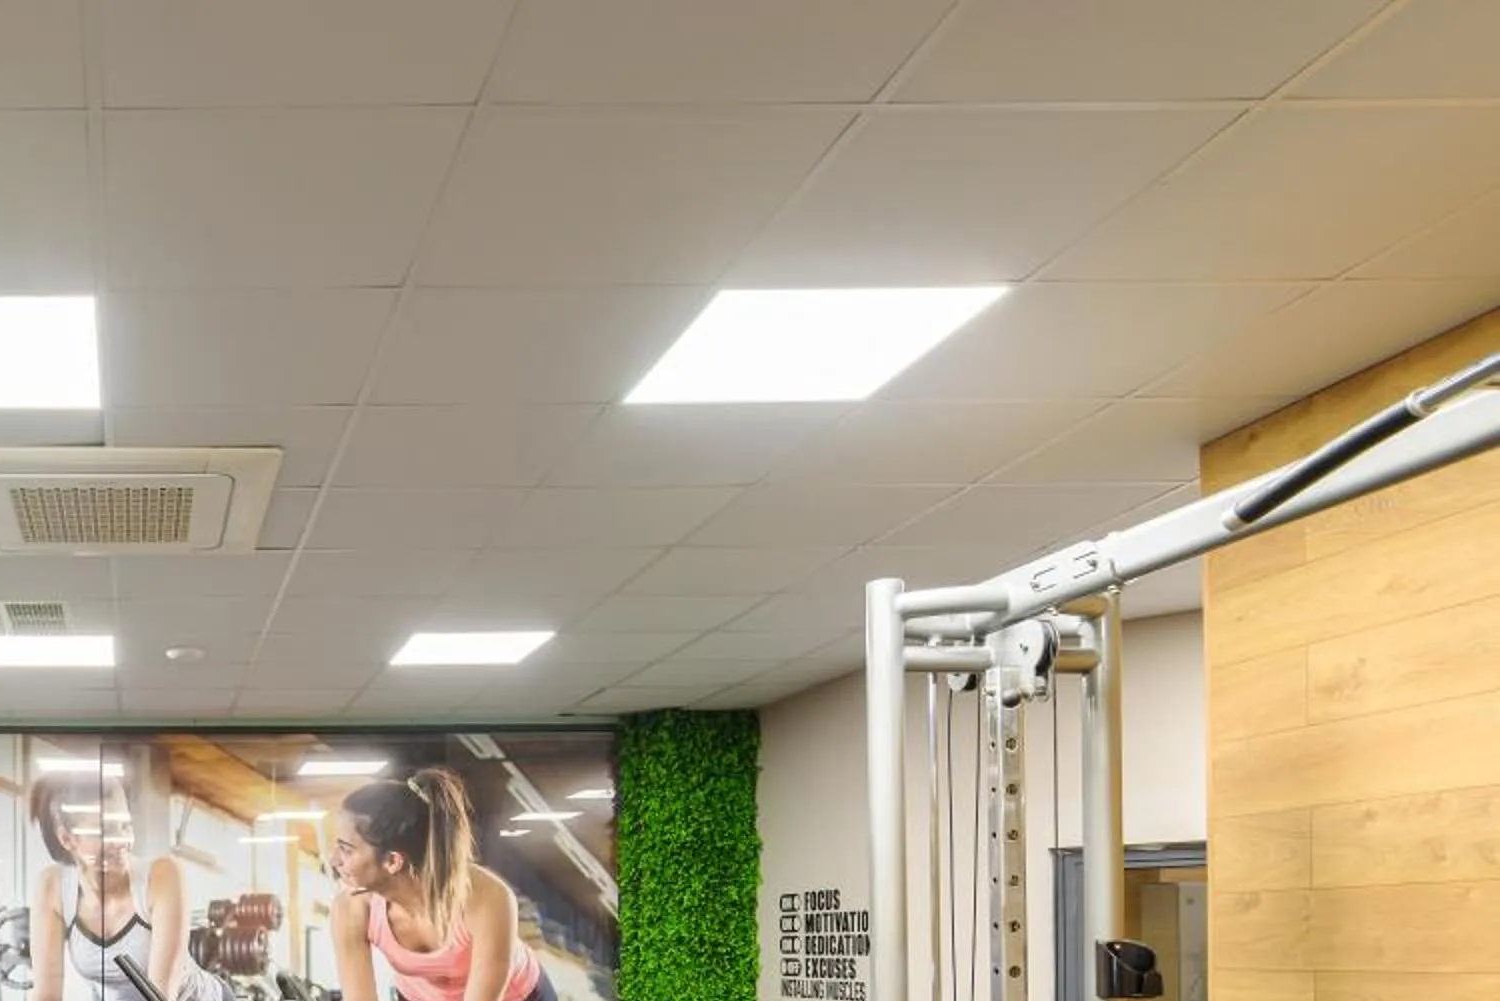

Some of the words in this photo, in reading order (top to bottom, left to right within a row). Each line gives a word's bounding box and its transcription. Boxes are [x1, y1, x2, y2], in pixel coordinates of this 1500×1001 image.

[804, 889, 840, 911] FOCUS
[804, 910, 869, 934] MOTIVATIO
[804, 958, 856, 979] EXCUSES
[780, 979, 824, 999] INSTALLING
[825, 980, 867, 1001] MUSCLES
